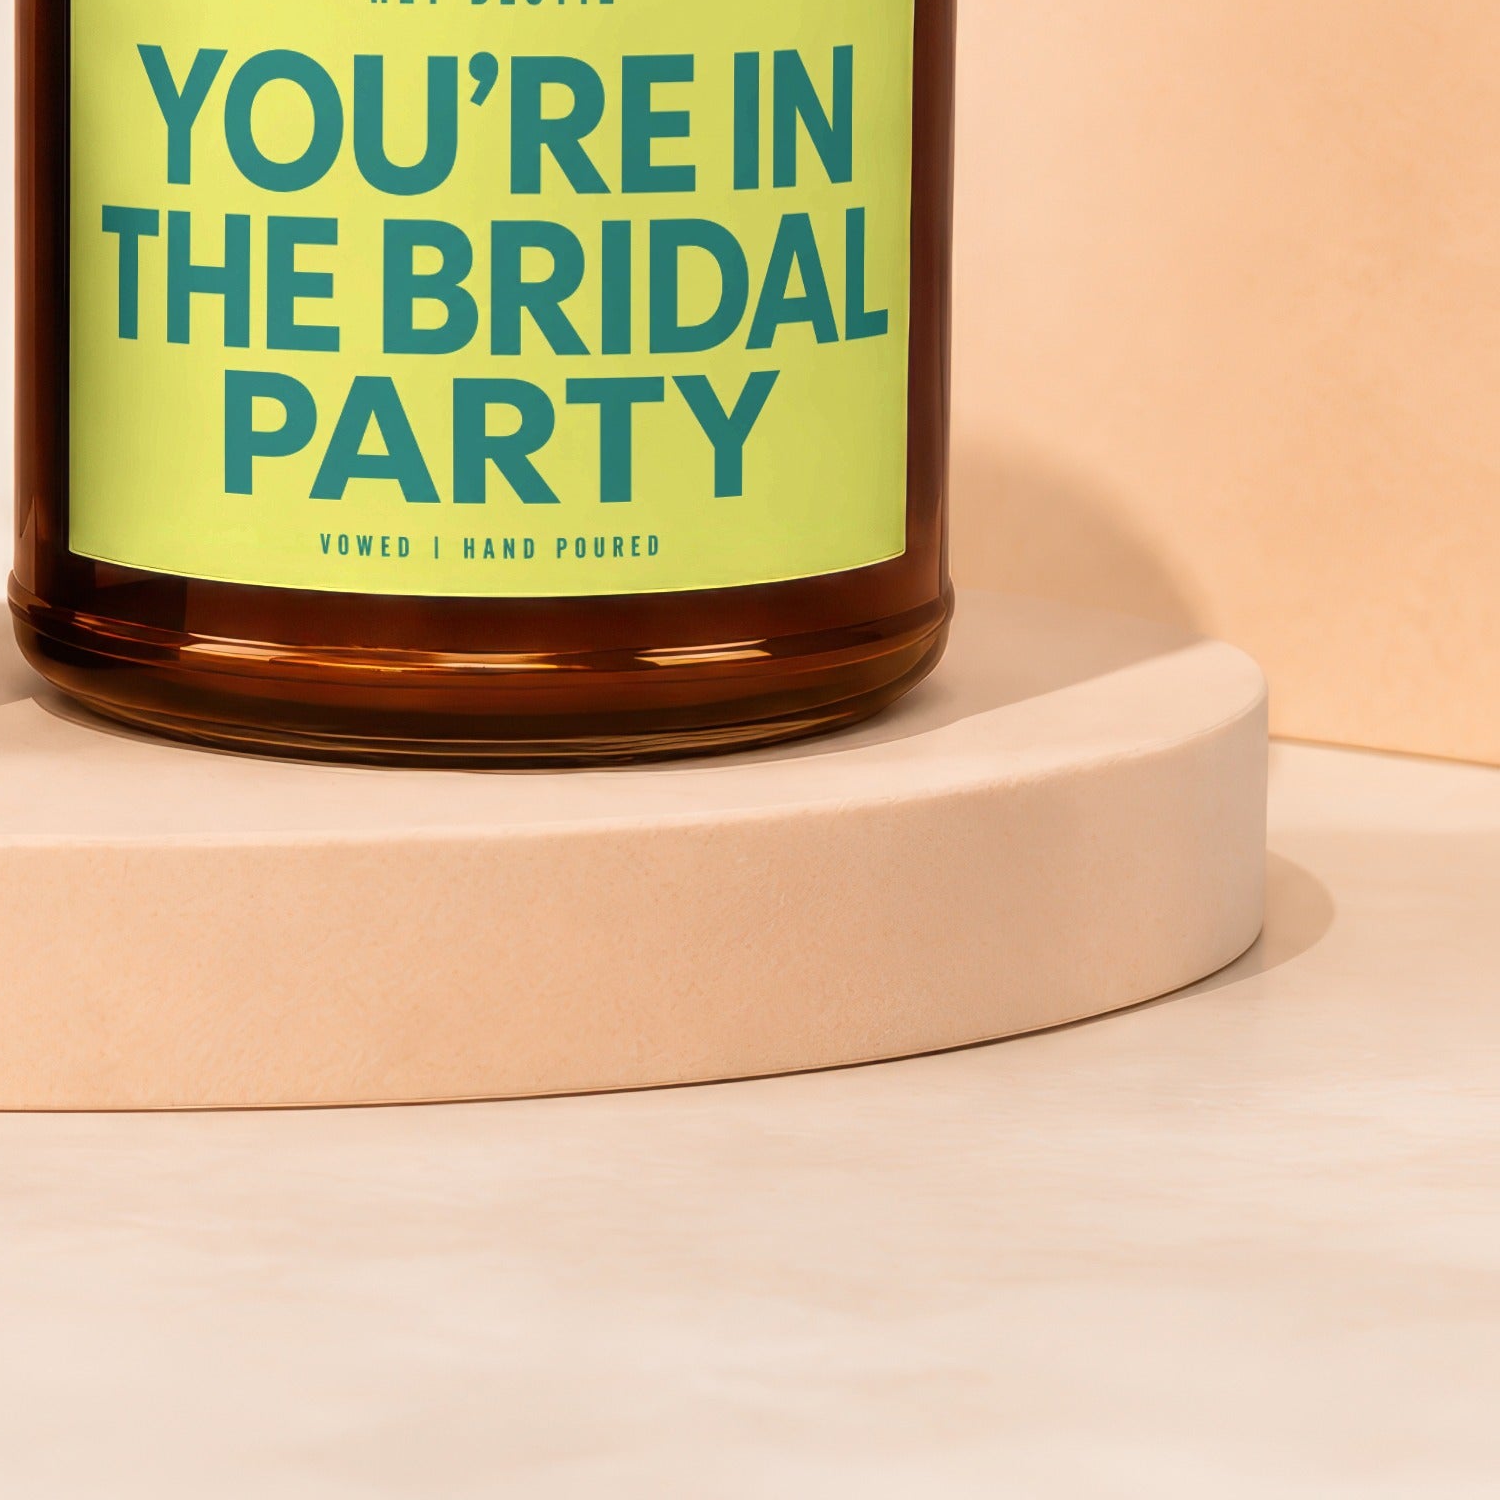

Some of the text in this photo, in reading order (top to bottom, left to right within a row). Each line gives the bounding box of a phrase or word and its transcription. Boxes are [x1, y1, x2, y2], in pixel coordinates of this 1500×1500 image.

[136, 43, 854, 197] YOU’RE IN
[101, 204, 889, 356] THE BRIDAL
[224, 369, 781, 505] PARTY
[320, 533, 410, 558] VOWED
[463, 537, 535, 560] HAND
[556, 534, 659, 560] POURED
